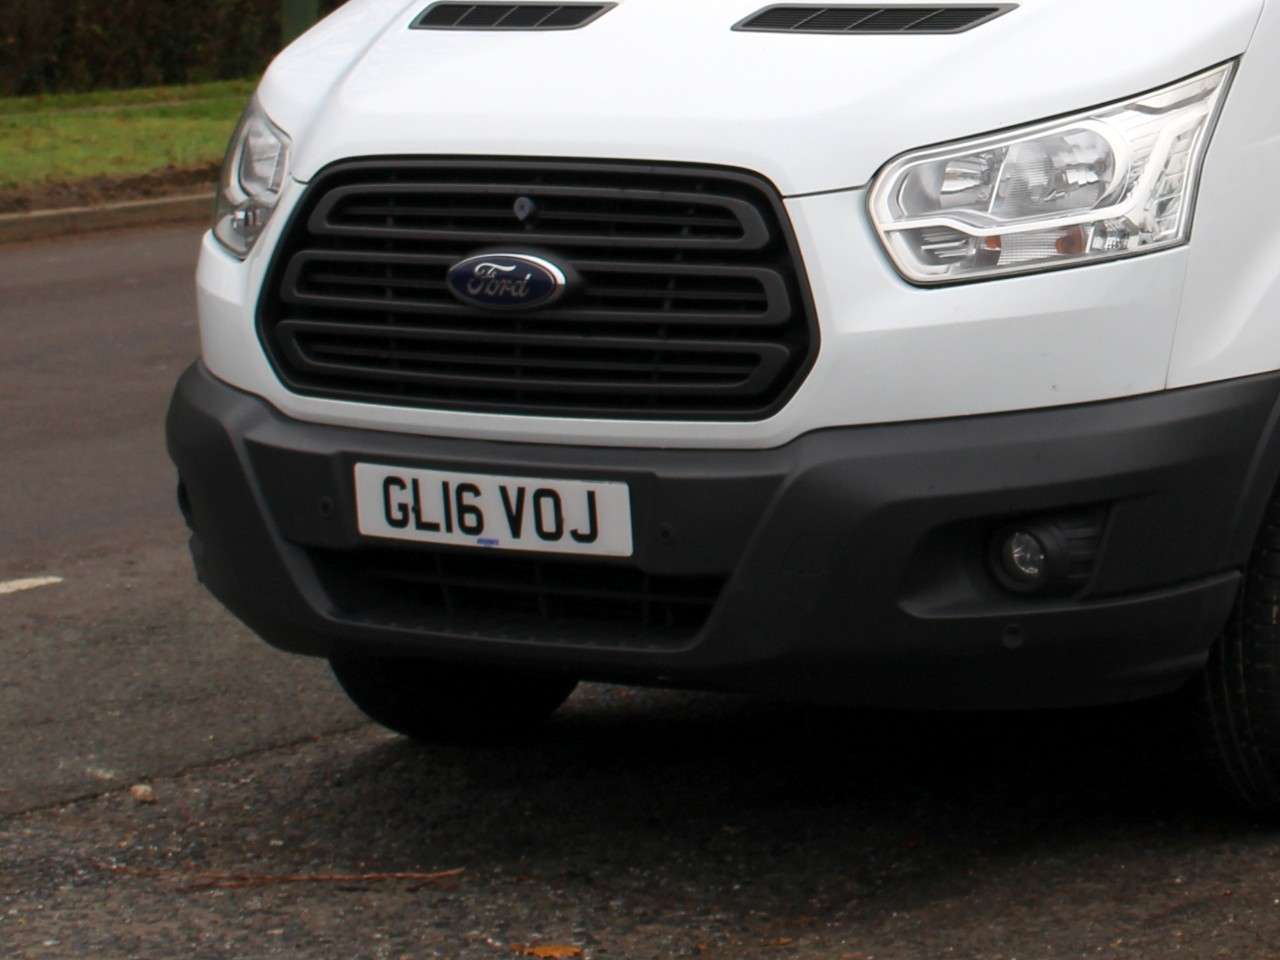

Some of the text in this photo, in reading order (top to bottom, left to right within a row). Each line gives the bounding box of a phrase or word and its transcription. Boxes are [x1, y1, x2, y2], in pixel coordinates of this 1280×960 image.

[467, 262, 531, 297] Ford
[382, 476, 599, 544] GL16 VOJ
